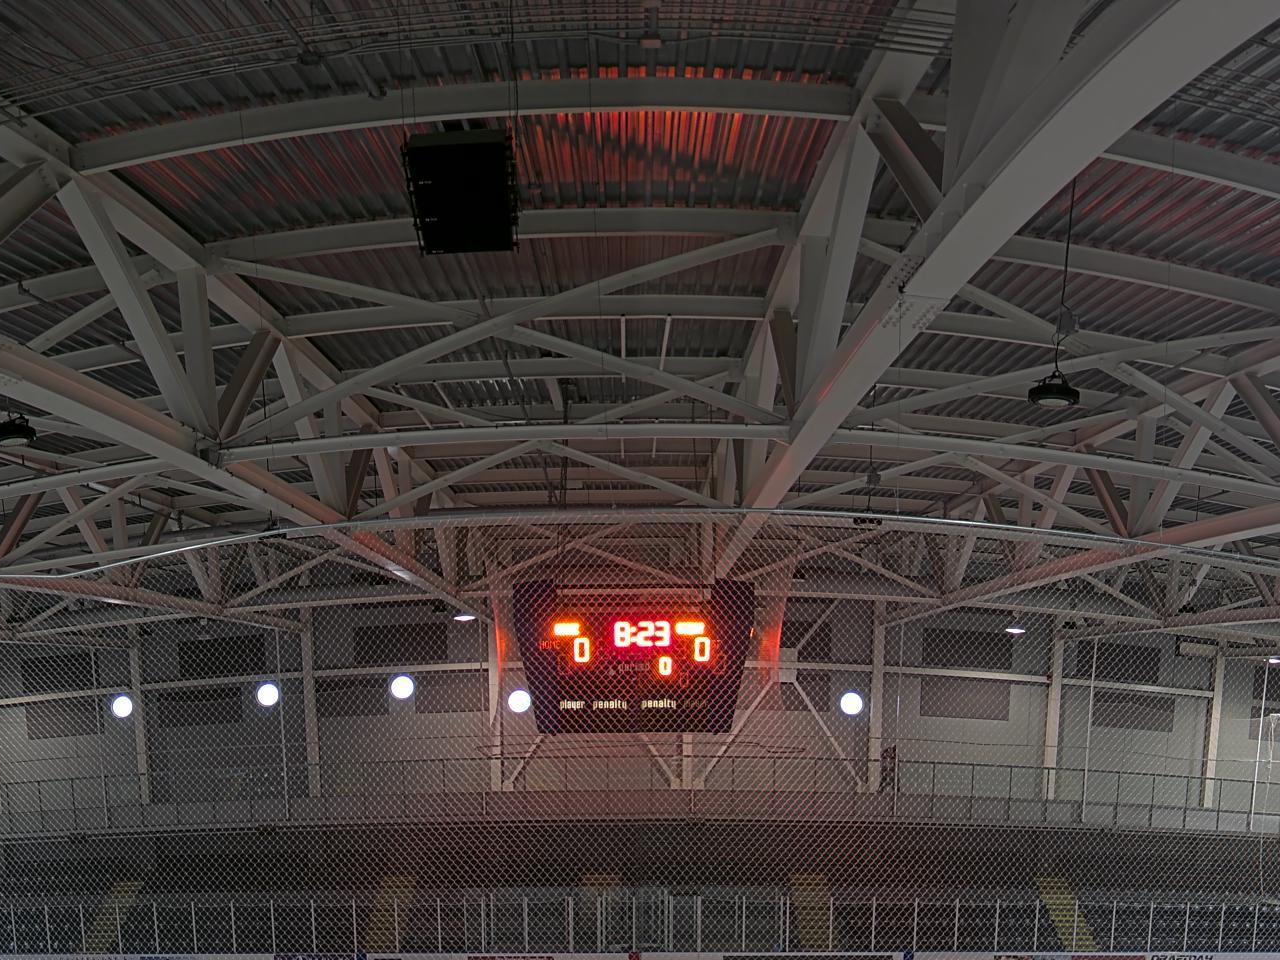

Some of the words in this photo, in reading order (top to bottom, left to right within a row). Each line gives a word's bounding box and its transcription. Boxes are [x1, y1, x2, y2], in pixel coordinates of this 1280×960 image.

[614, 621, 670, 647] 8:23
[574, 637, 590, 662] 0
[694, 637, 710, 661] 0
[659, 656, 672, 675] 0
[559, 699, 585, 710] player
[592, 699, 627, 710] penalty
[641, 699, 677, 710] penalty
